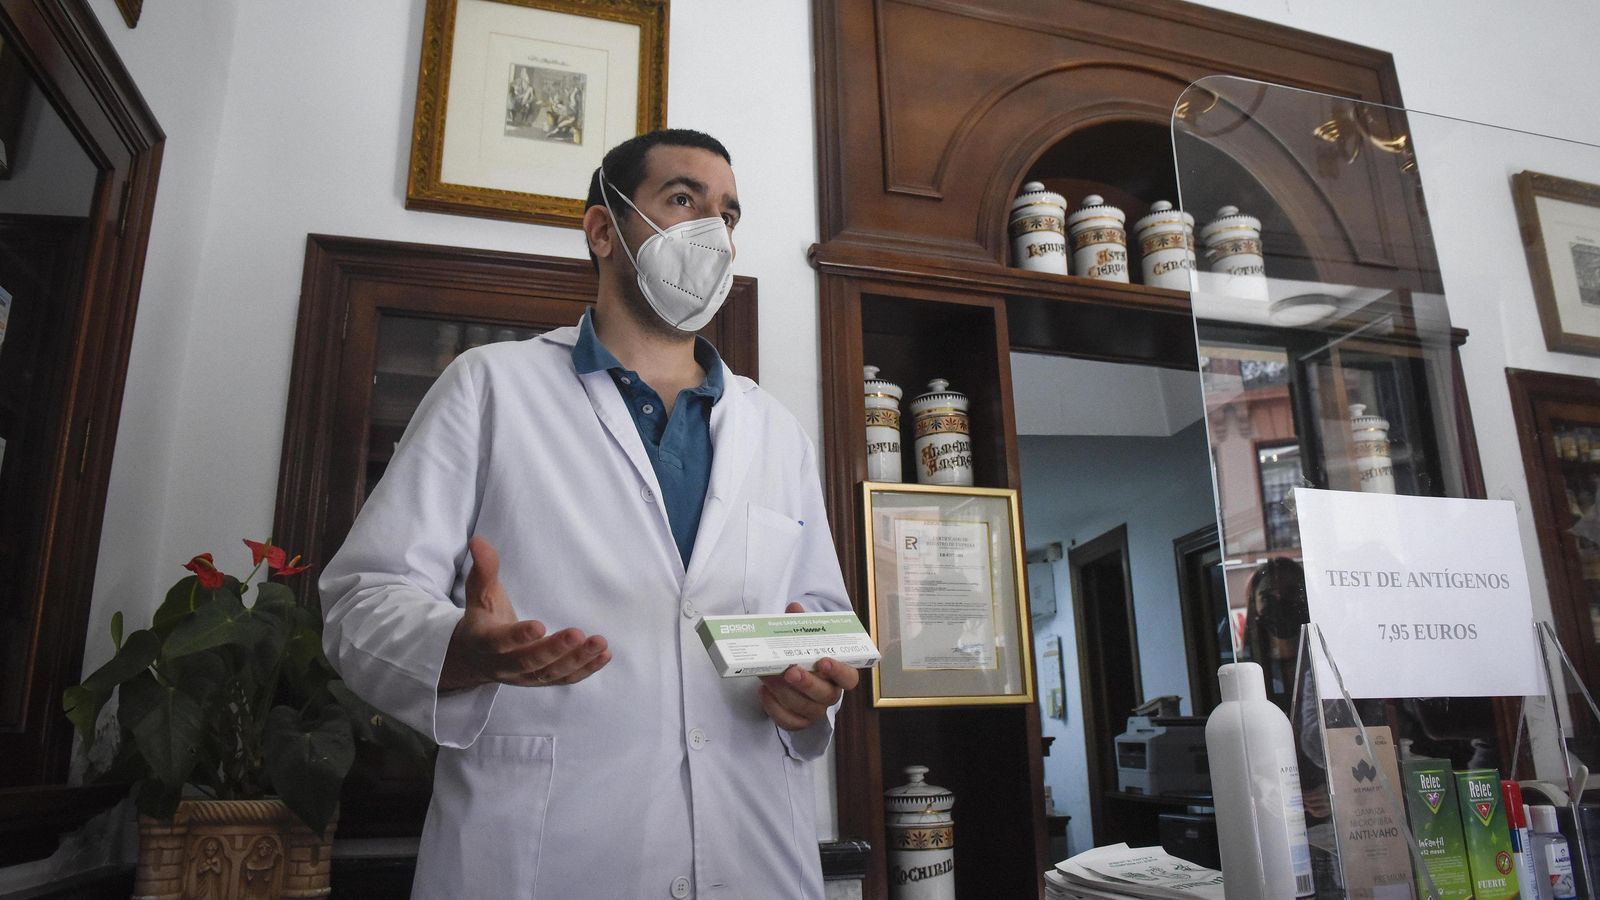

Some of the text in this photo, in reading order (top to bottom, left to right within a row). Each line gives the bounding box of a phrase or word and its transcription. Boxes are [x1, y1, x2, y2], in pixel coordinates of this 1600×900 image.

[1325, 568, 1510, 590] TEST DE ANTÍGENOS
[1378, 623, 1478, 643] 7,95 EUROS
[1420, 774, 1441, 789] Relec
[1469, 780, 1492, 797] Relec
[1350, 827, 1398, 840] ANTI-VAHO
[1478, 879, 1506, 888] FUERTE
